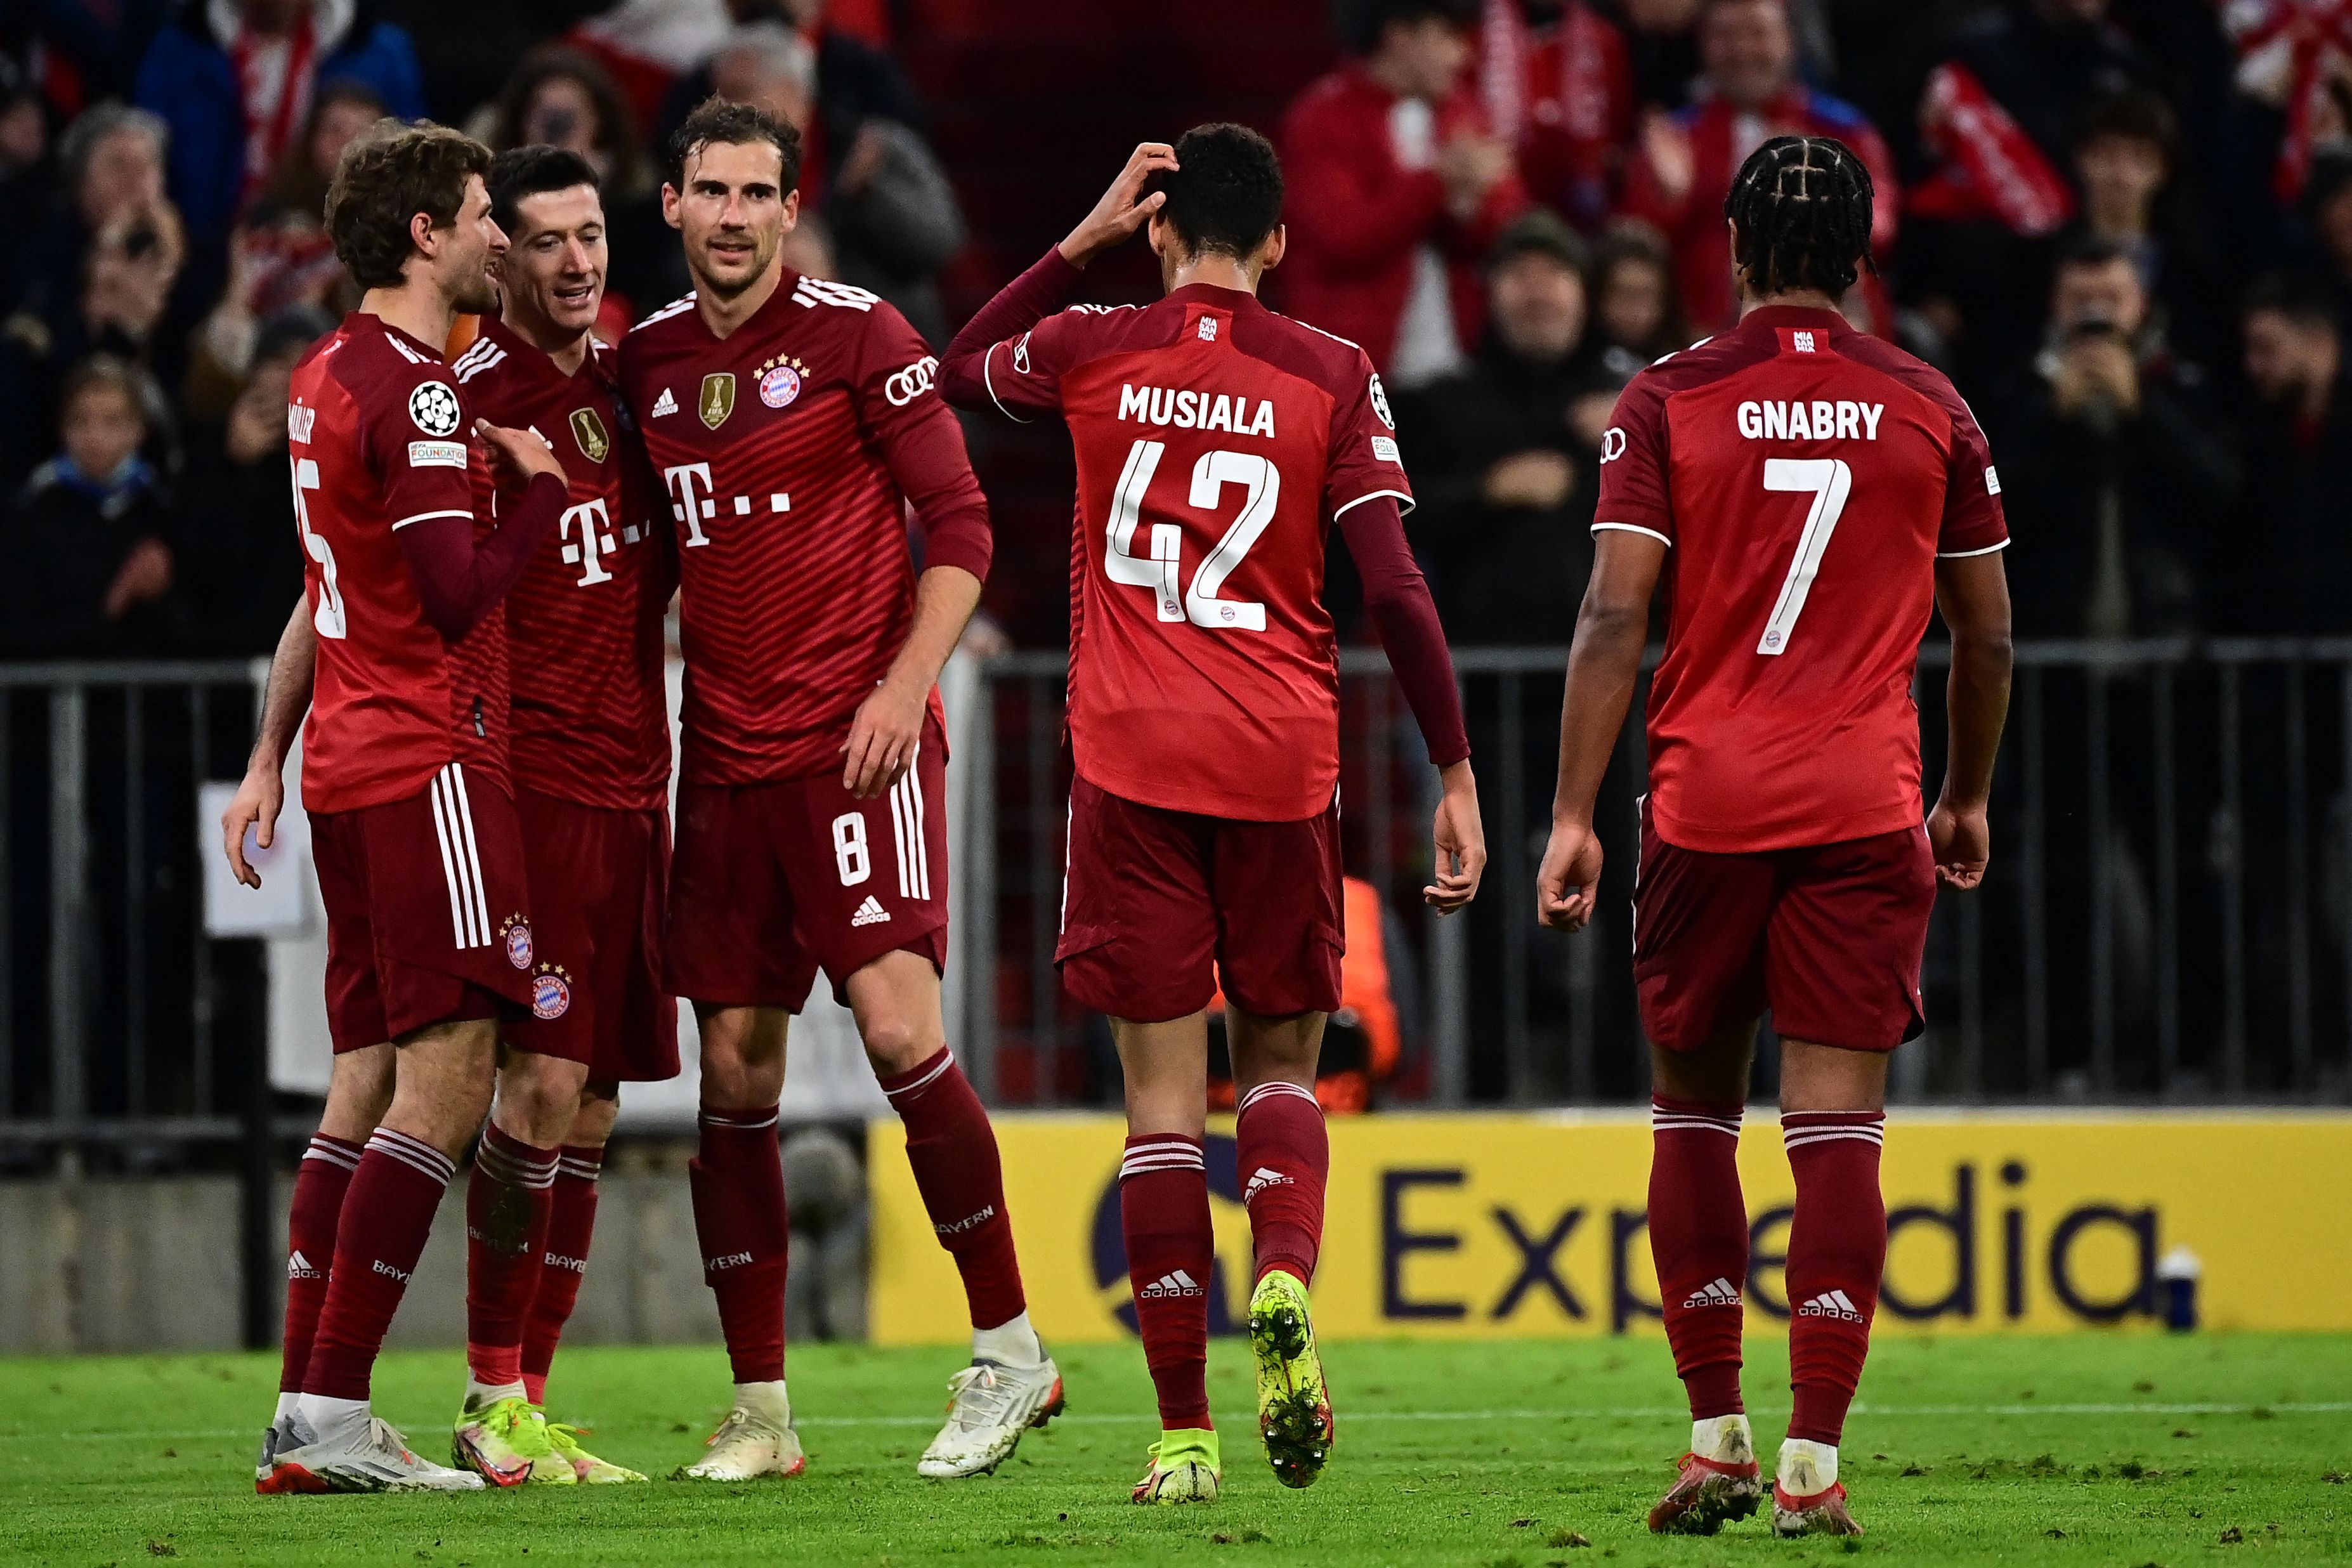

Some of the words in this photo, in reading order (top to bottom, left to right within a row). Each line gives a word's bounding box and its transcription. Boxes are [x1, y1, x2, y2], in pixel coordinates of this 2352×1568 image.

[1117, 384, 1276, 438] MUSIALA
[1737, 400, 1885, 441] GNABRY
[1104, 440, 1281, 632] 42
[1756, 458, 1852, 655] 7
[832, 811, 871, 886] 8
[851, 911, 891, 927] adidas
[1246, 1177, 1295, 1210] adidas
[934, 1205, 994, 1234] AYERN
[1380, 1161, 2158, 1335] Expedia
[1140, 1288, 1204, 1298] adidas
[1683, 1295, 1744, 1309] adidas
[1798, 1305, 1864, 1324] adidas
